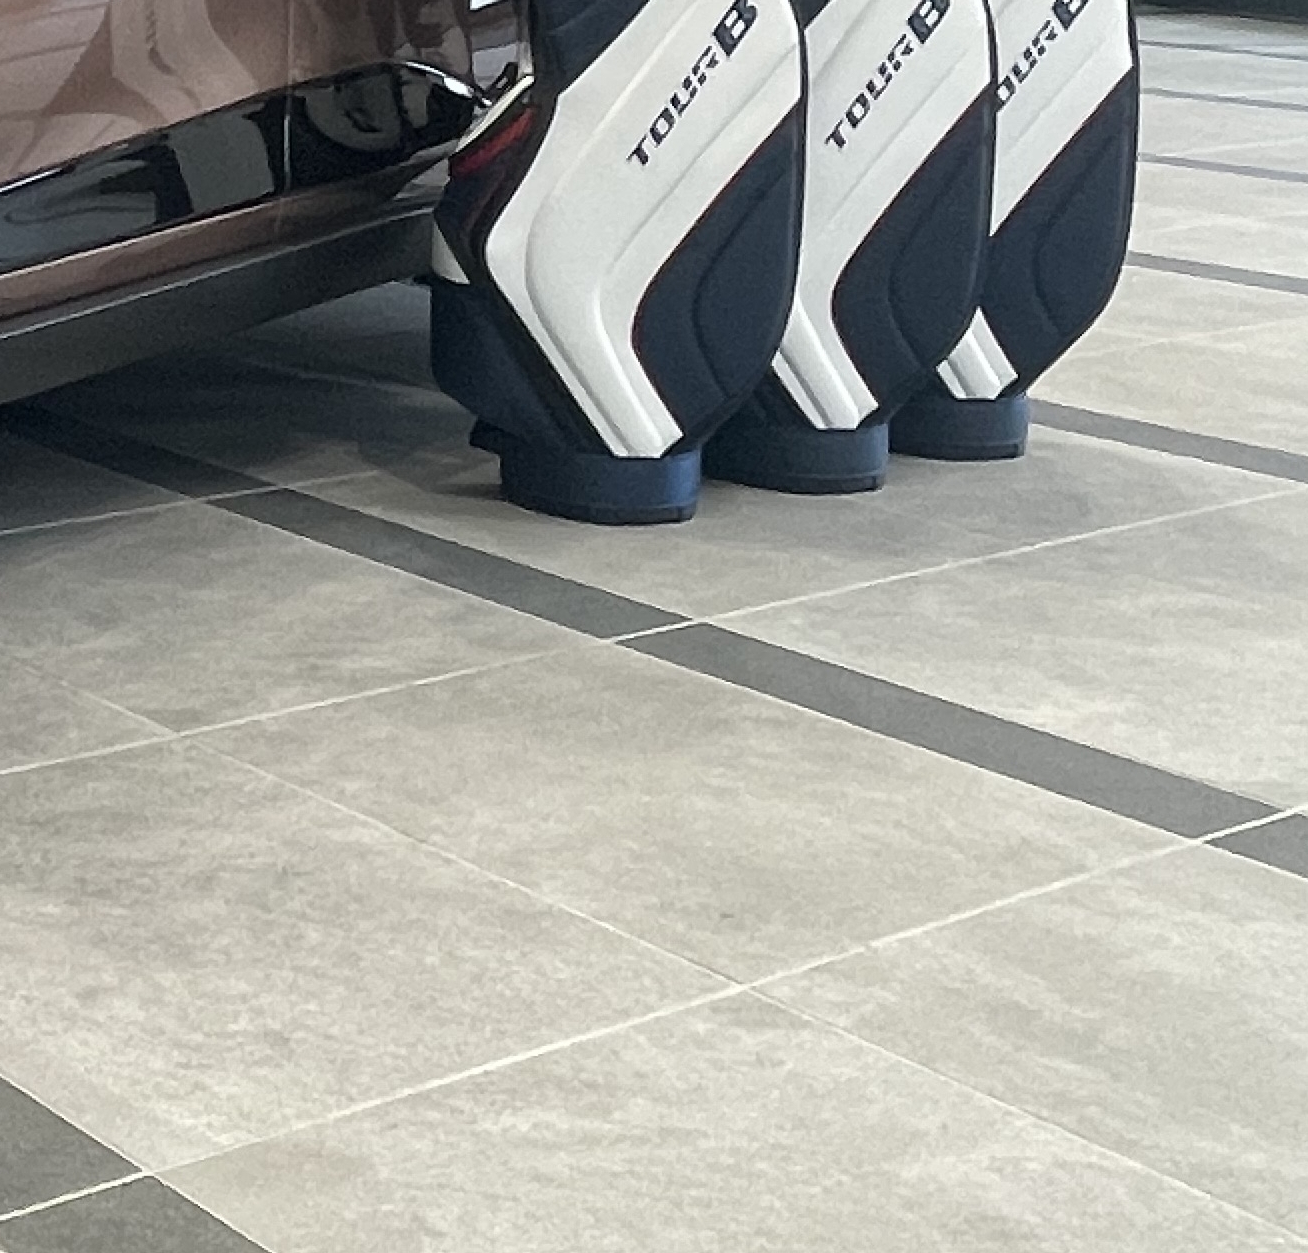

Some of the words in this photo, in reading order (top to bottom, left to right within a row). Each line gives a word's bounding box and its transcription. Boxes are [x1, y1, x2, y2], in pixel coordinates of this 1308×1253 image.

[627, 45, 719, 166] TOUR
[825, 34, 916, 150] TOUR
[995, 19, 1059, 106] OUR
